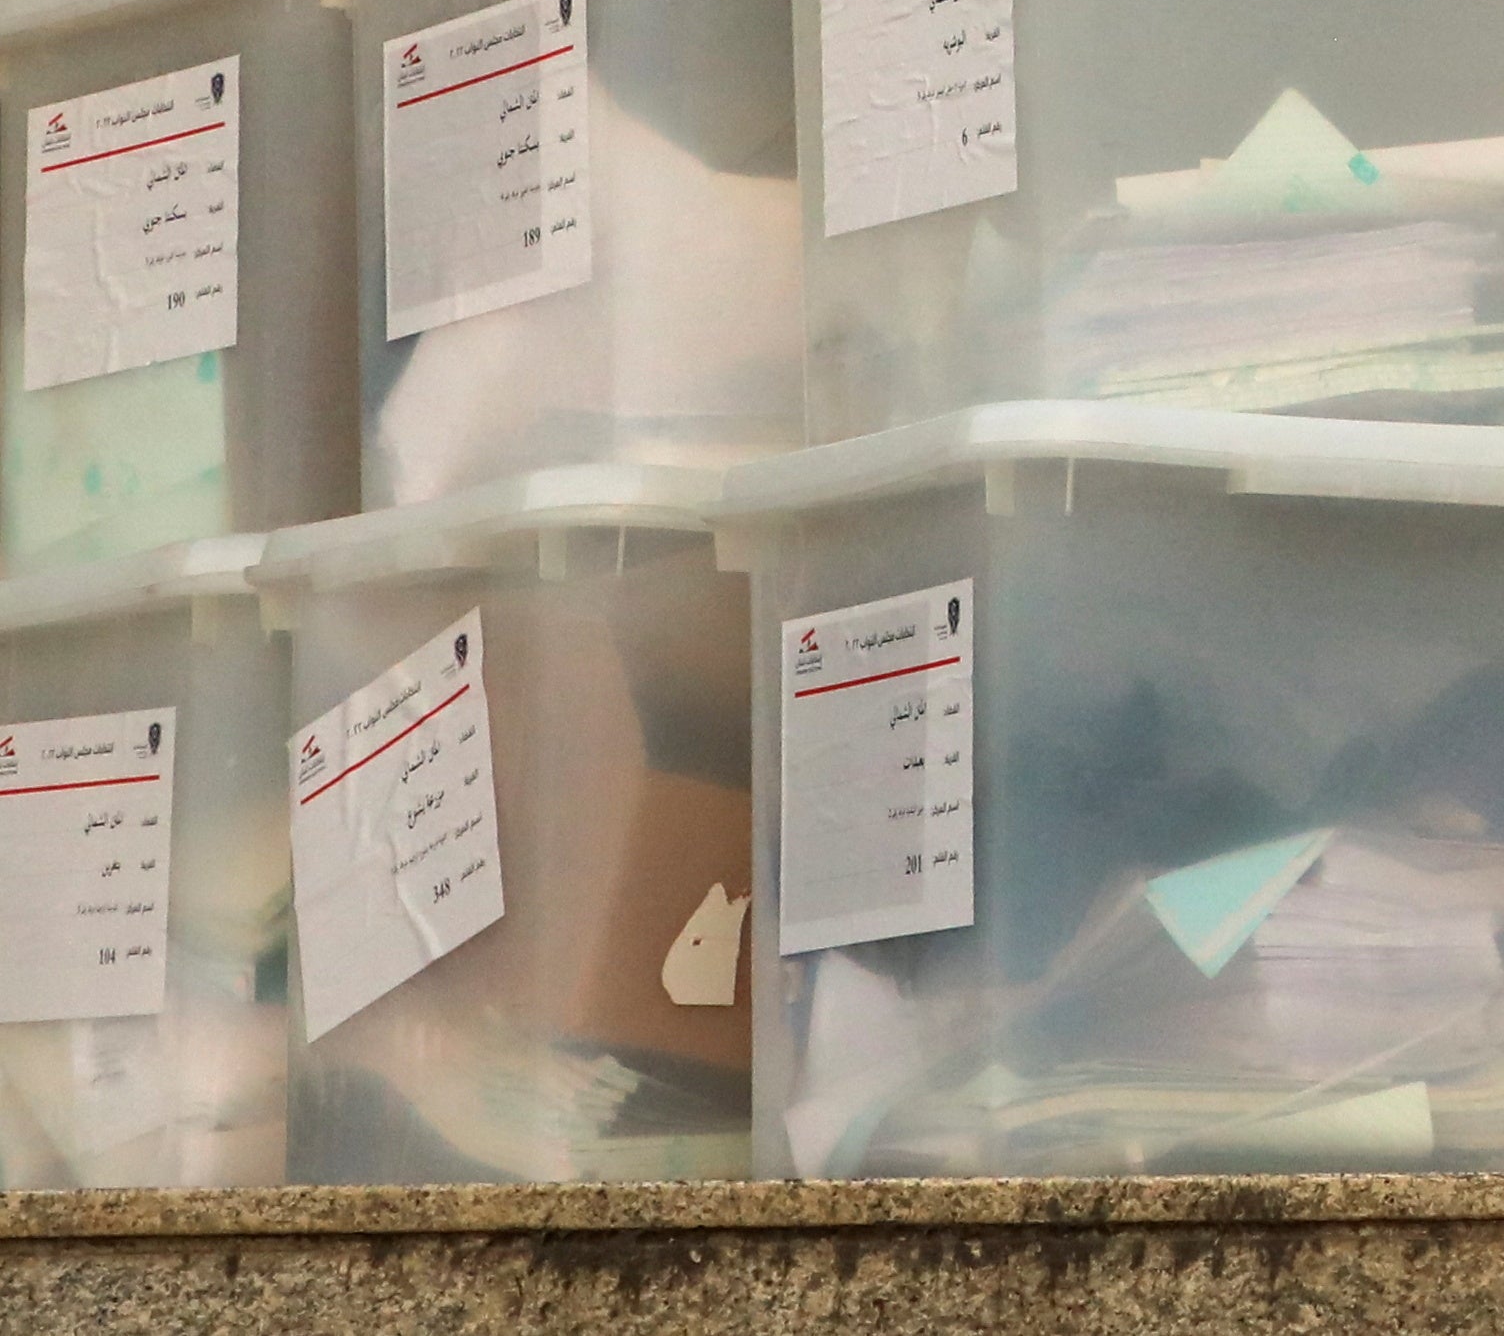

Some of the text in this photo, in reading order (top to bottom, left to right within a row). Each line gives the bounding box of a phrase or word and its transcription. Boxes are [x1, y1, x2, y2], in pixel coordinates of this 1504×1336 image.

[961, 128, 969, 147] 6
[167, 291, 186, 311] 190
[905, 854, 923, 875] 201
[99, 948, 116, 965] 104
